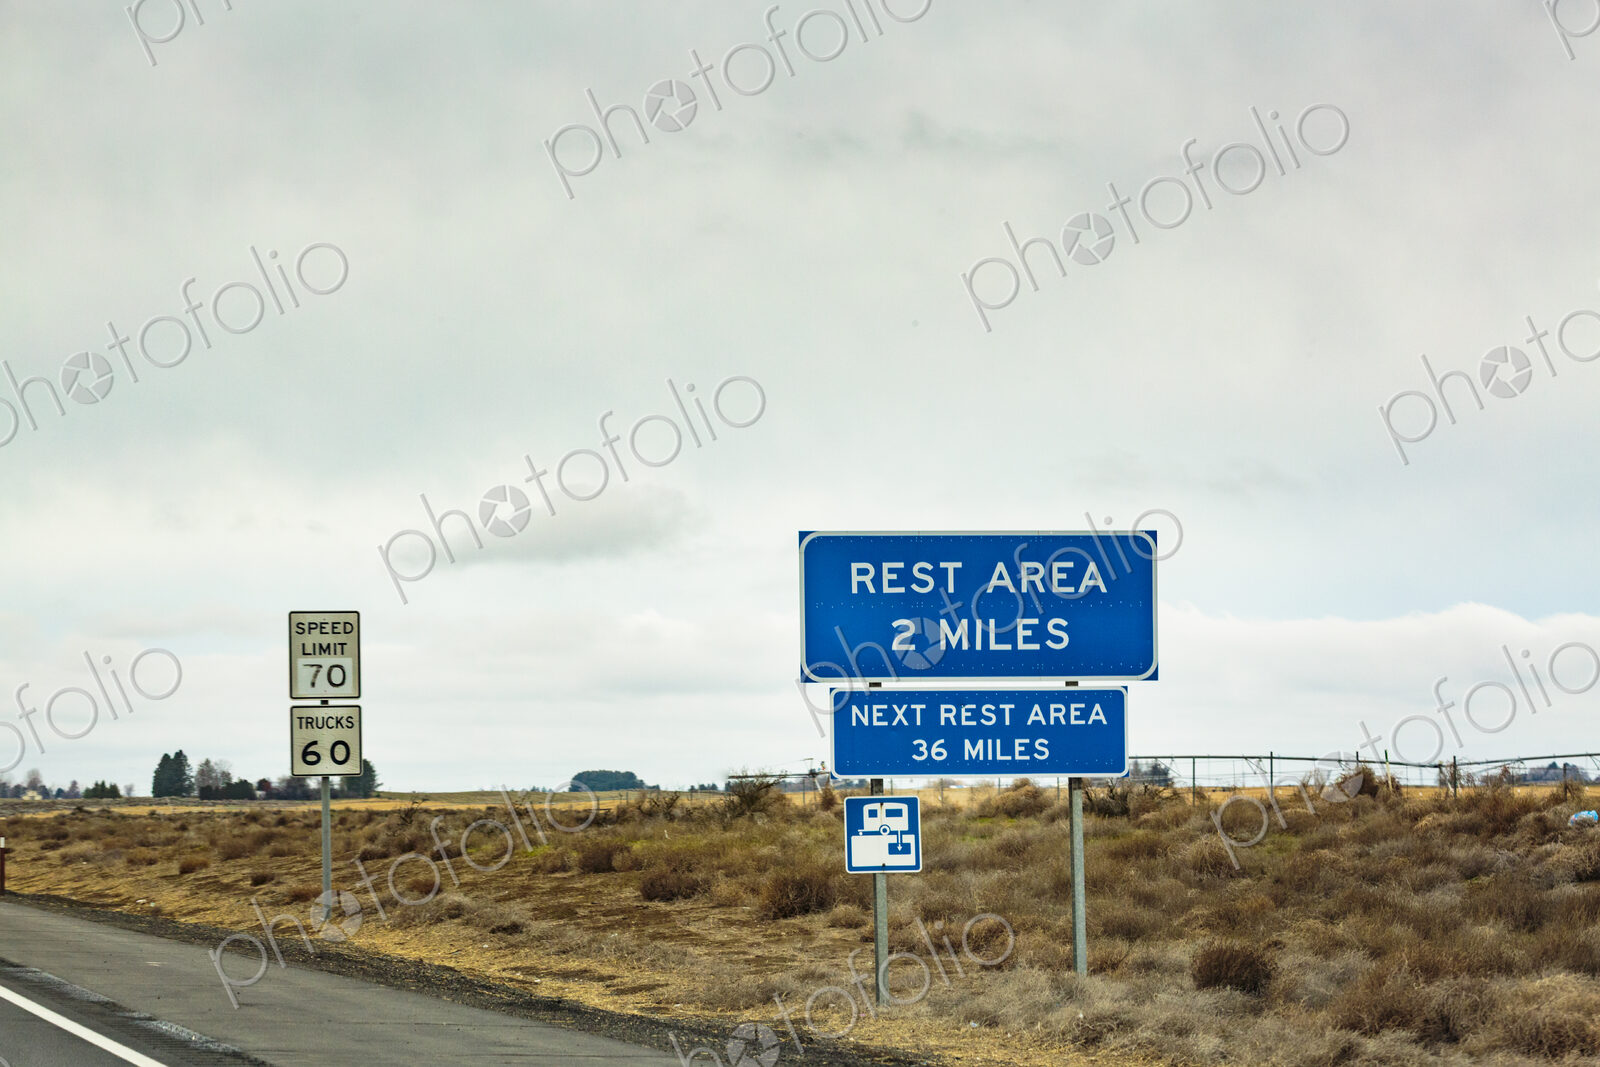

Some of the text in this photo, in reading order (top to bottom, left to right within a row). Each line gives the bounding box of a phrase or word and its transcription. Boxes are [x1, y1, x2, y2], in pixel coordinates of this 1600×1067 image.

[850, 561, 1107, 594] REST AREA
[295, 621, 354, 635] SPEED
[891, 618, 1070, 651] 2 MILES
[302, 642, 347, 656] LIMIT
[302, 664, 347, 688] 70
[297, 716, 355, 730] TRUCKS
[851, 703, 1108, 726] NEXT REST AREA
[301, 740, 351, 766] 60
[912, 738, 1050, 761] 36 MILES
